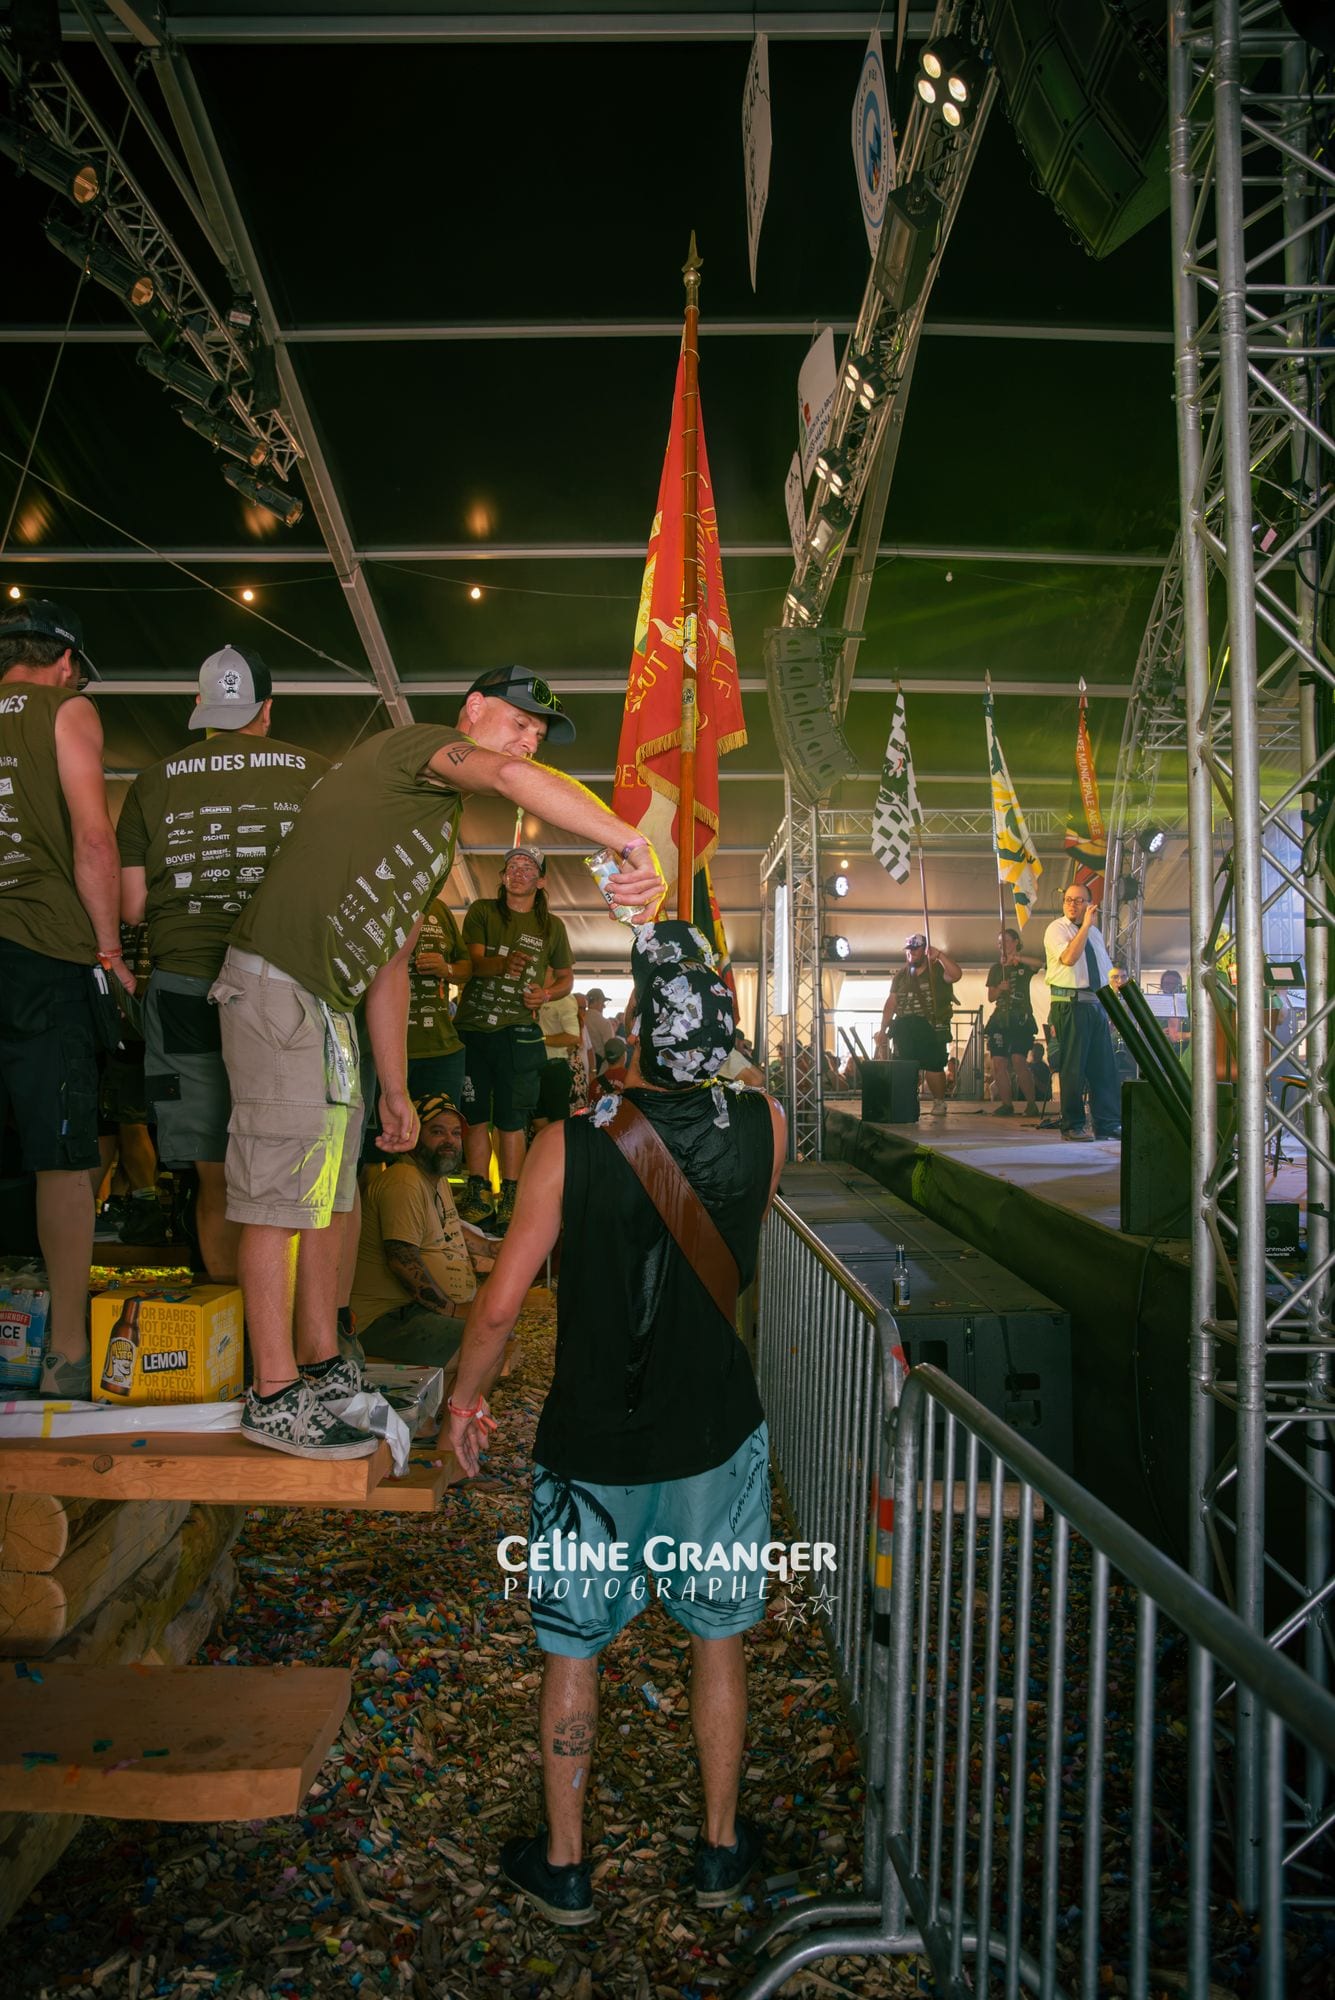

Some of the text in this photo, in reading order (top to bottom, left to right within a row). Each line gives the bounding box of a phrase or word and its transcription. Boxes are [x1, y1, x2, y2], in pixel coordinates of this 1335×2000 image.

[166, 752, 306, 778] NAIN DES MINES
[1088, 808, 1101, 835] AIGLE
[166, 852, 196, 865] BOVEN
[158, 1307, 197, 1323] BABIES
[160, 1322, 197, 1337] PEACH
[148, 1334, 173, 1349] ICED
[175, 1336, 197, 1351] TEA
[143, 1350, 187, 1371] LEMON
[138, 1373, 197, 1392] FOR DETOX
[146, 1388, 197, 1403] NOT BEER
